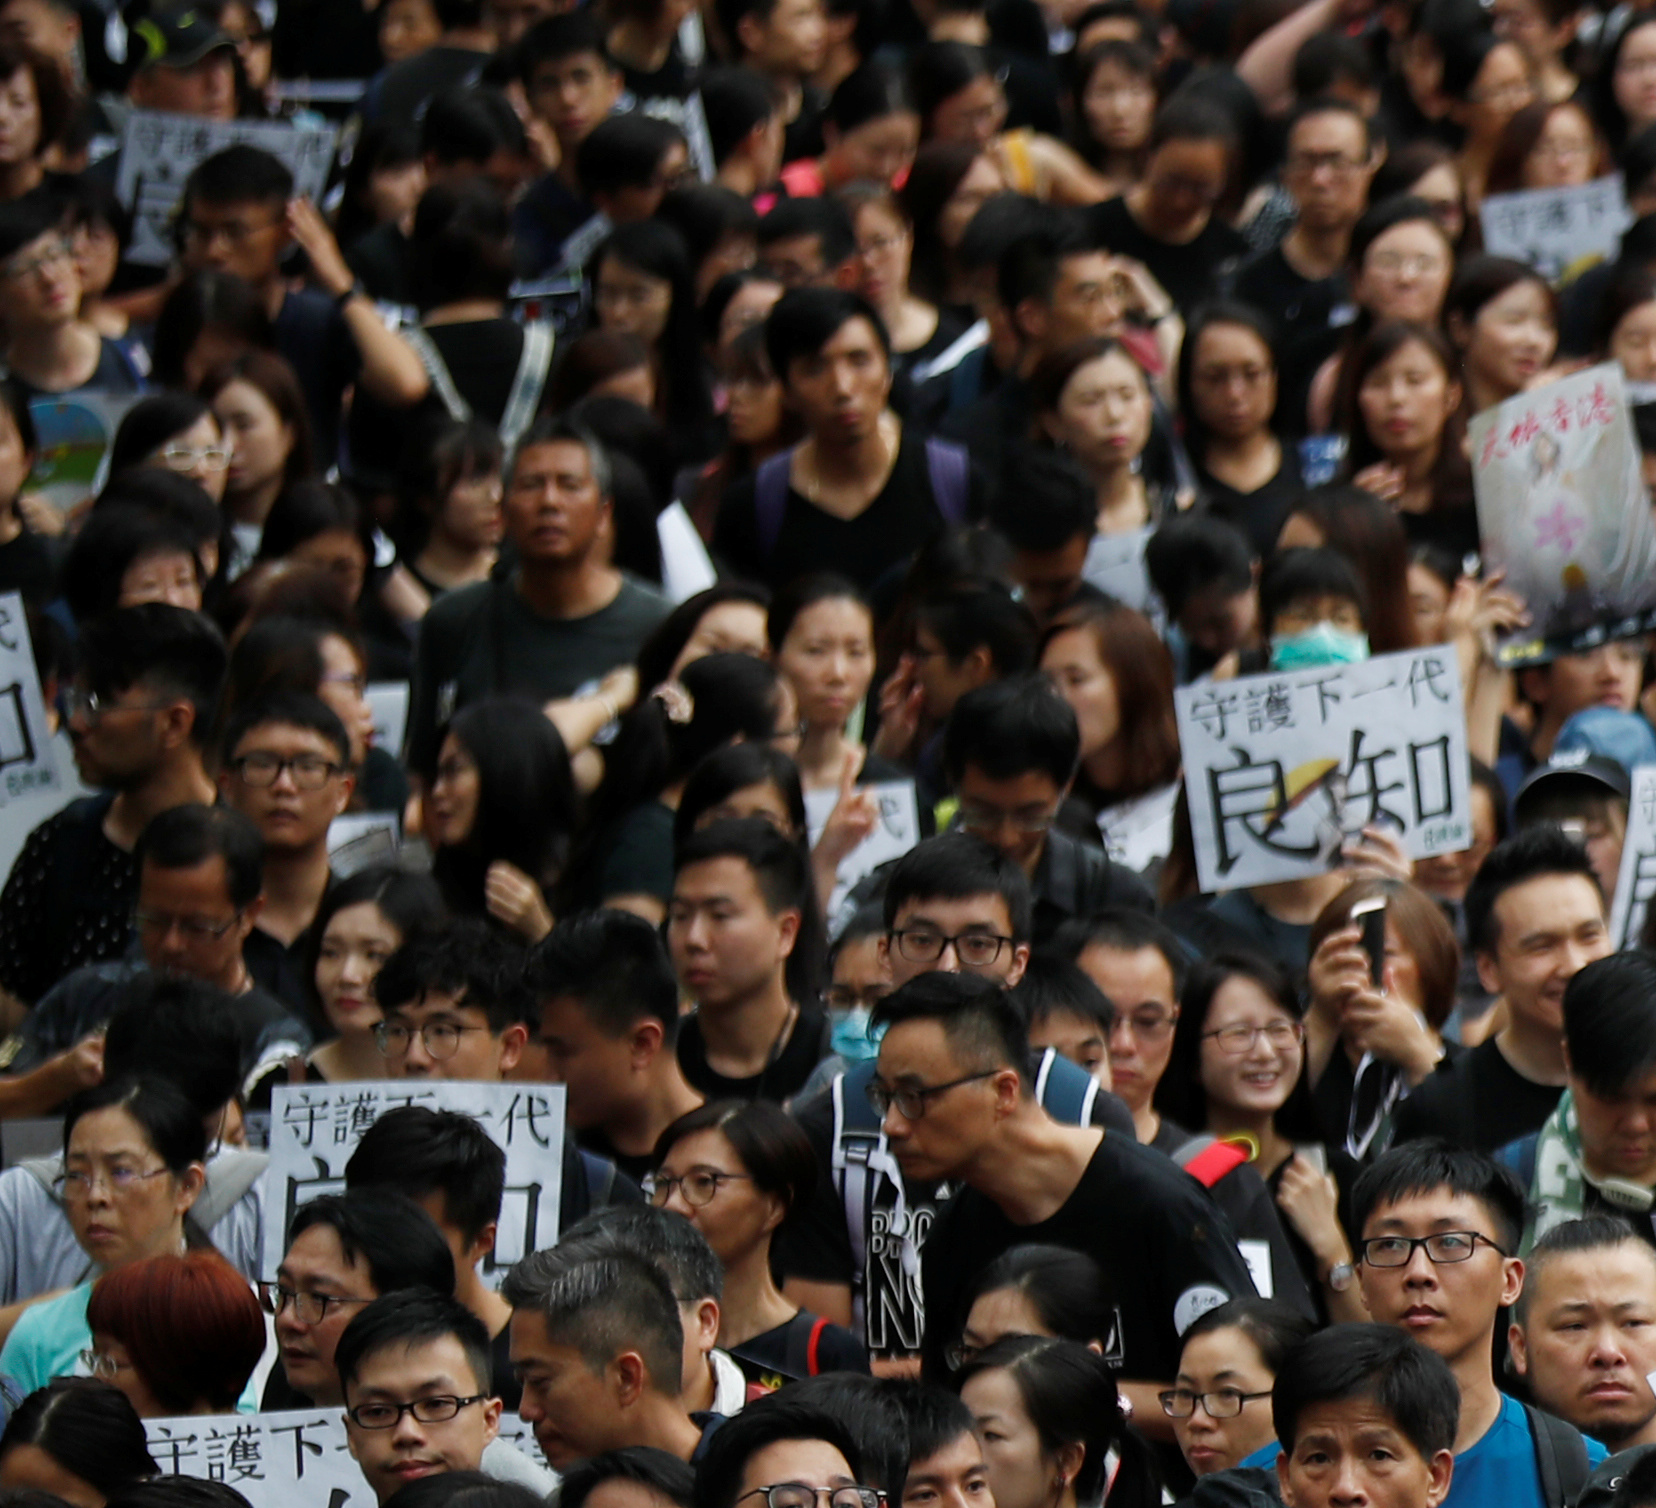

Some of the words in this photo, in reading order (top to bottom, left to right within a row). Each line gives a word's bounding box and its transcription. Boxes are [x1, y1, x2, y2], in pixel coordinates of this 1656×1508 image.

[1190, 656, 1451, 742] 守護下一代
[1204, 728, 1454, 876] 良知
